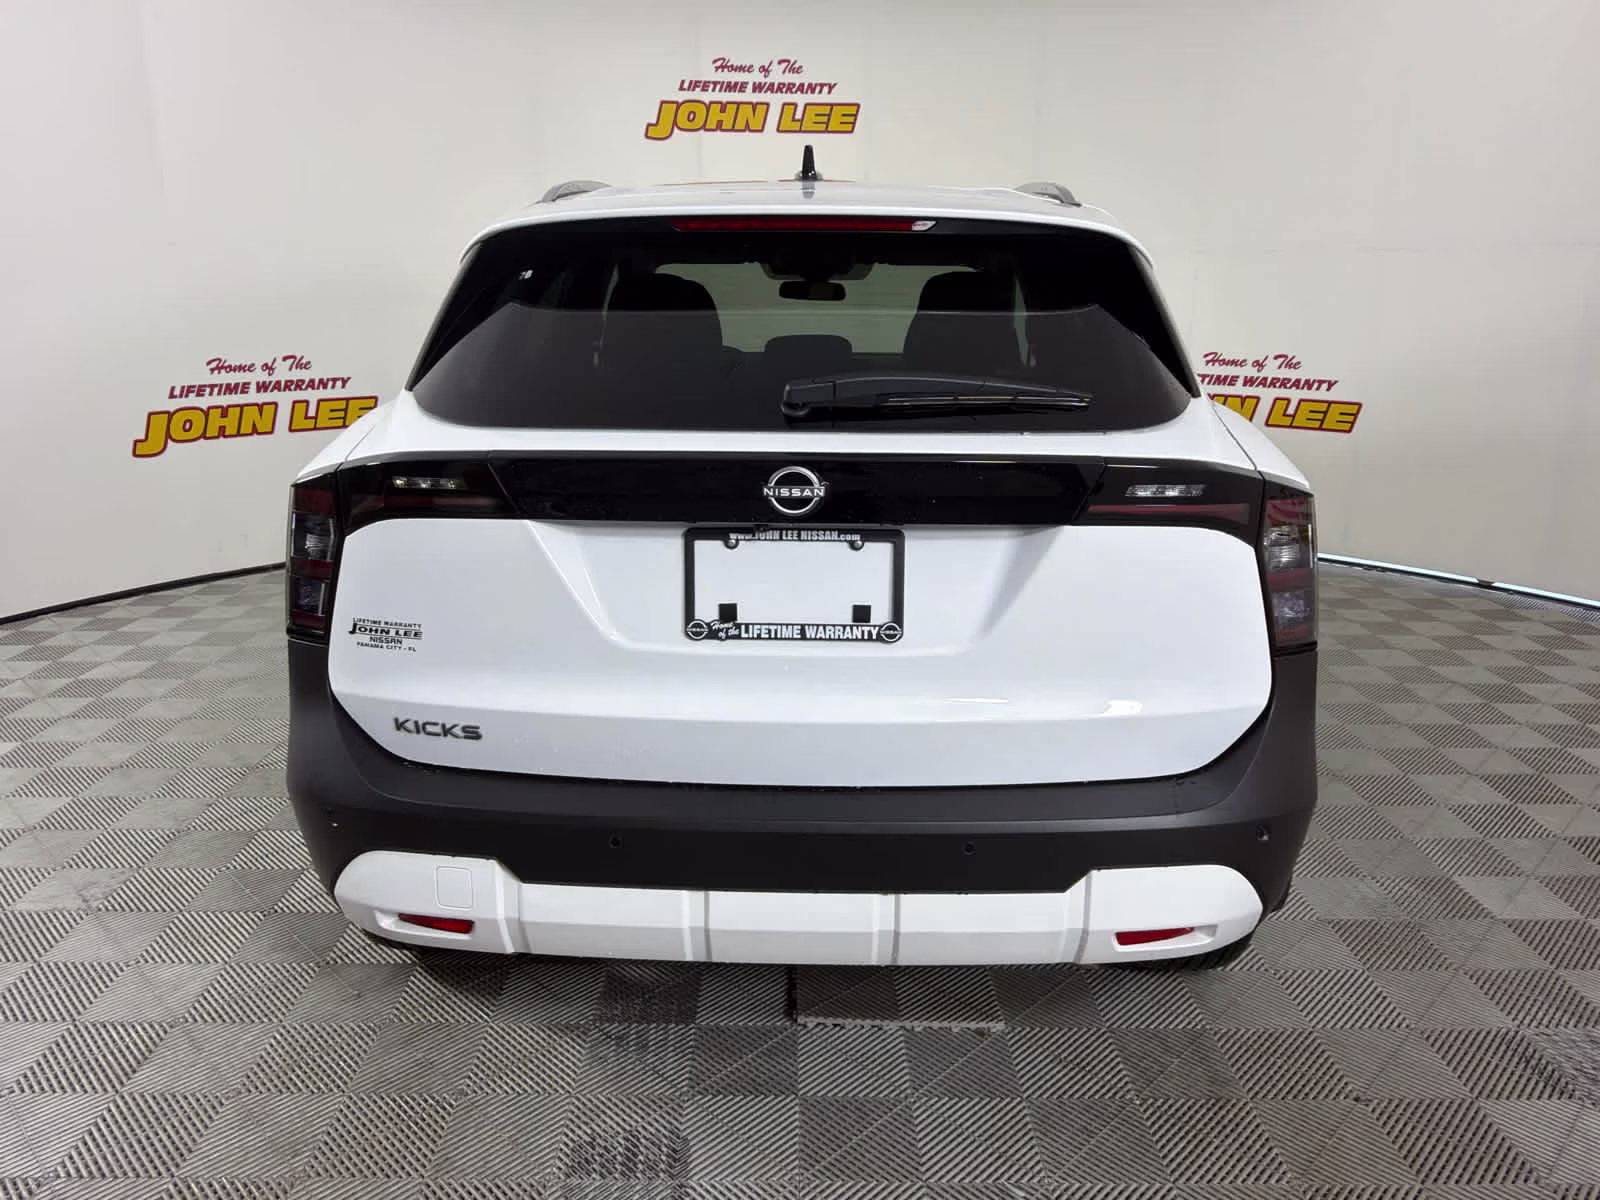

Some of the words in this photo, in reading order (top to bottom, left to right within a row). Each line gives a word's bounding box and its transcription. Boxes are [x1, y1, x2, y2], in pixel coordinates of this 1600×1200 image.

[712, 57, 754, 74] Home
[758, 60, 773, 78] of
[777, 59, 803, 75] The
[678, 79, 749, 93] LIFETIME
[752, 81, 837, 95] WARRANTY
[645, 100, 770, 141] JOHN
[776, 102, 860, 134] LEE
[206, 357, 255, 375] Home
[261, 358, 277, 376] of
[282, 355, 312, 372] The
[1203, 352, 1248, 369] Home
[1251, 355, 1268, 373] of
[1273, 354, 1302, 370] The
[168, 381, 250, 399] LIFETIME
[255, 376, 352, 394] WARRANTY
[1197, 373, 1240, 386] TIME
[1242, 375, 1339, 392] WARRANTY
[1264, 396, 1363, 434] LEE
[132, 401, 278, 458] JOHN
[288, 395, 378, 432] LEE
[763, 487, 825, 497] NISSAN
[782, 530, 799, 540] LEE
[800, 530, 860, 540] NISSAN.com
[348, 623, 390, 635] JOHN
[395, 629, 423, 638] LEE
[352, 617, 381, 625] LIFETIME
[370, 636, 402, 644] NISSAN
[741, 625, 801, 639] LIFETIME
[805, 625, 879, 640] WARRANTY
[393, 717, 483, 740] KICKS
